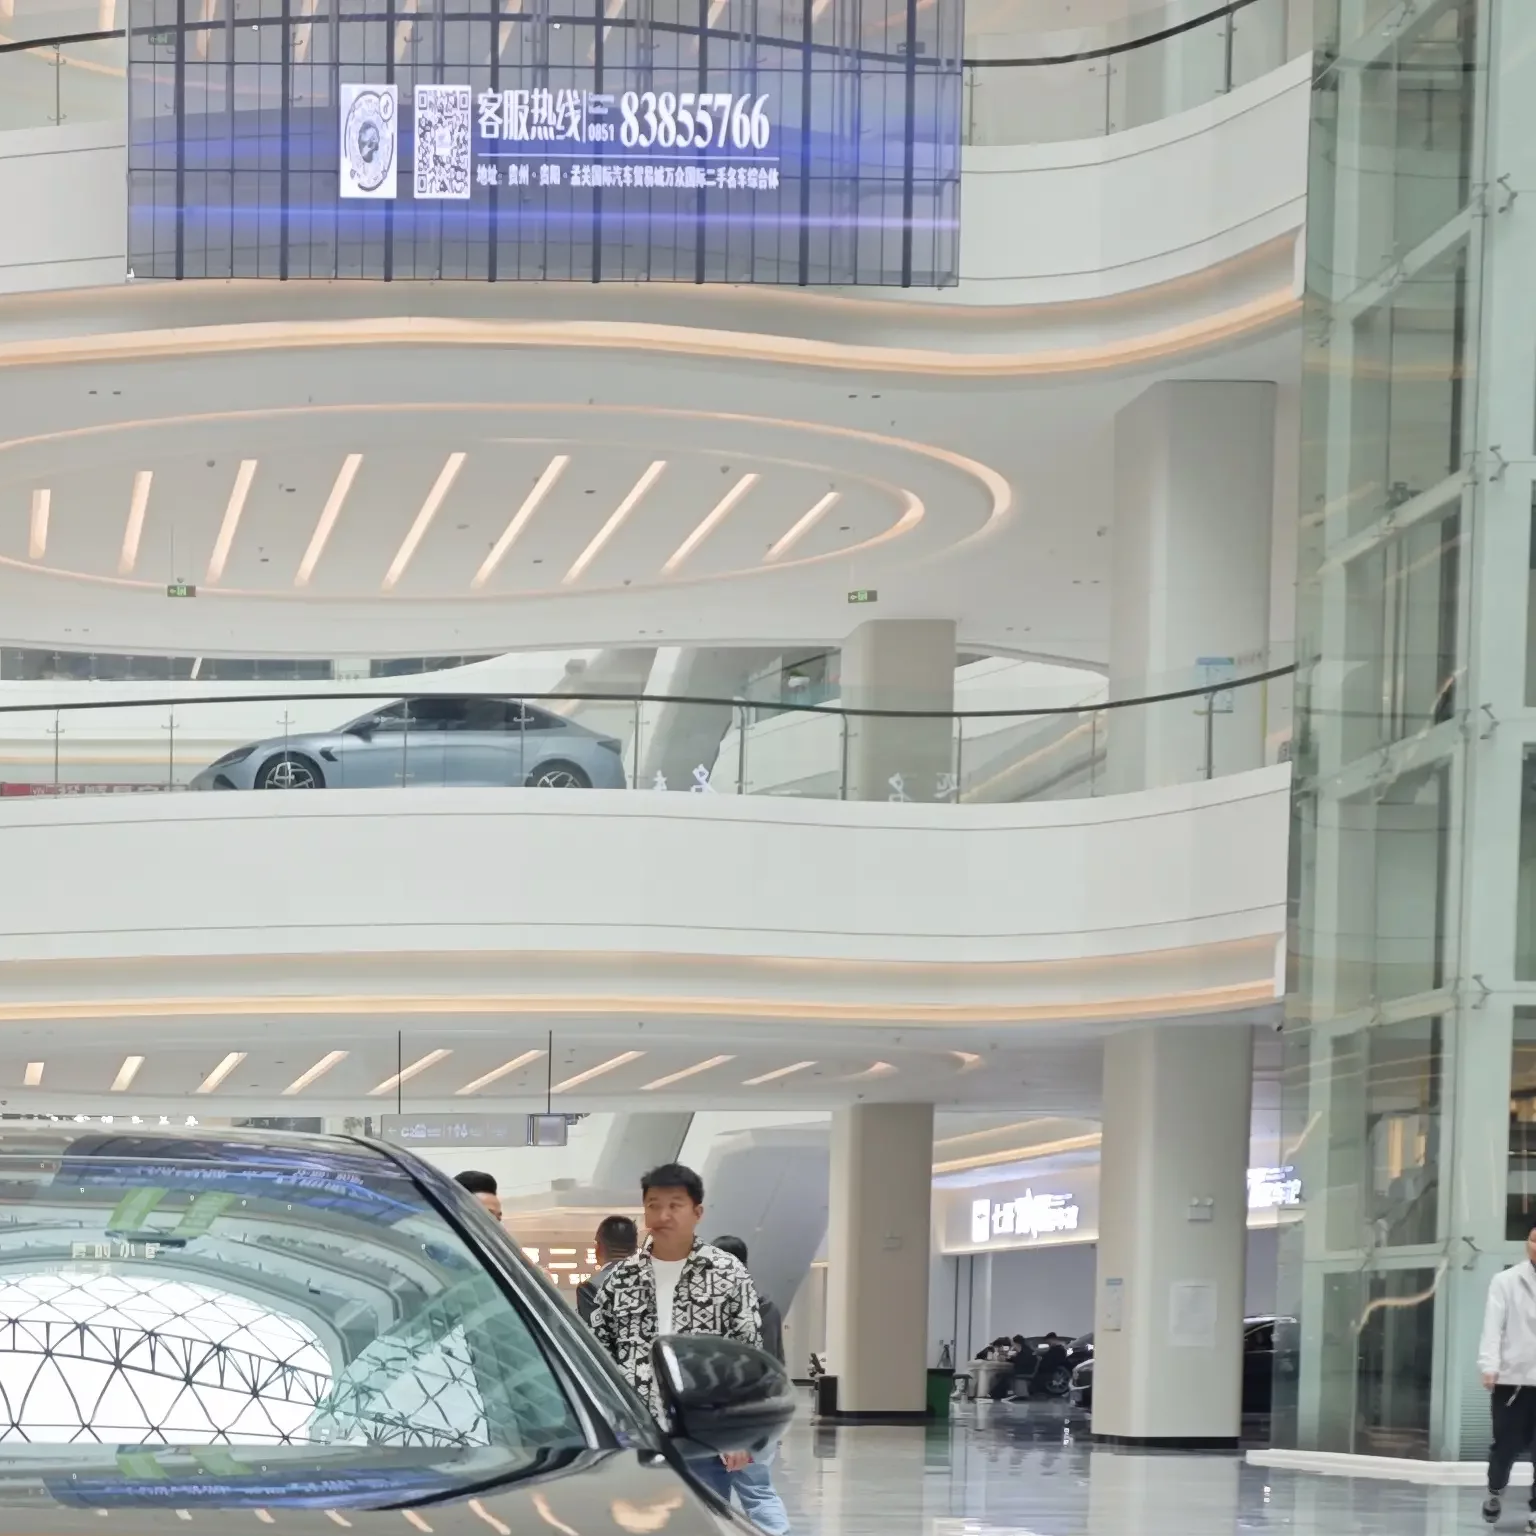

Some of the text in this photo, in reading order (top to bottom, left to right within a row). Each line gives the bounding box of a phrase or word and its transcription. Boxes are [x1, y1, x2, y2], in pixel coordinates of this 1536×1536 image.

[478, 88, 581, 142] 客服热线
[588, 123, 615, 142] 0851
[620, 91, 771, 149] 83855766
